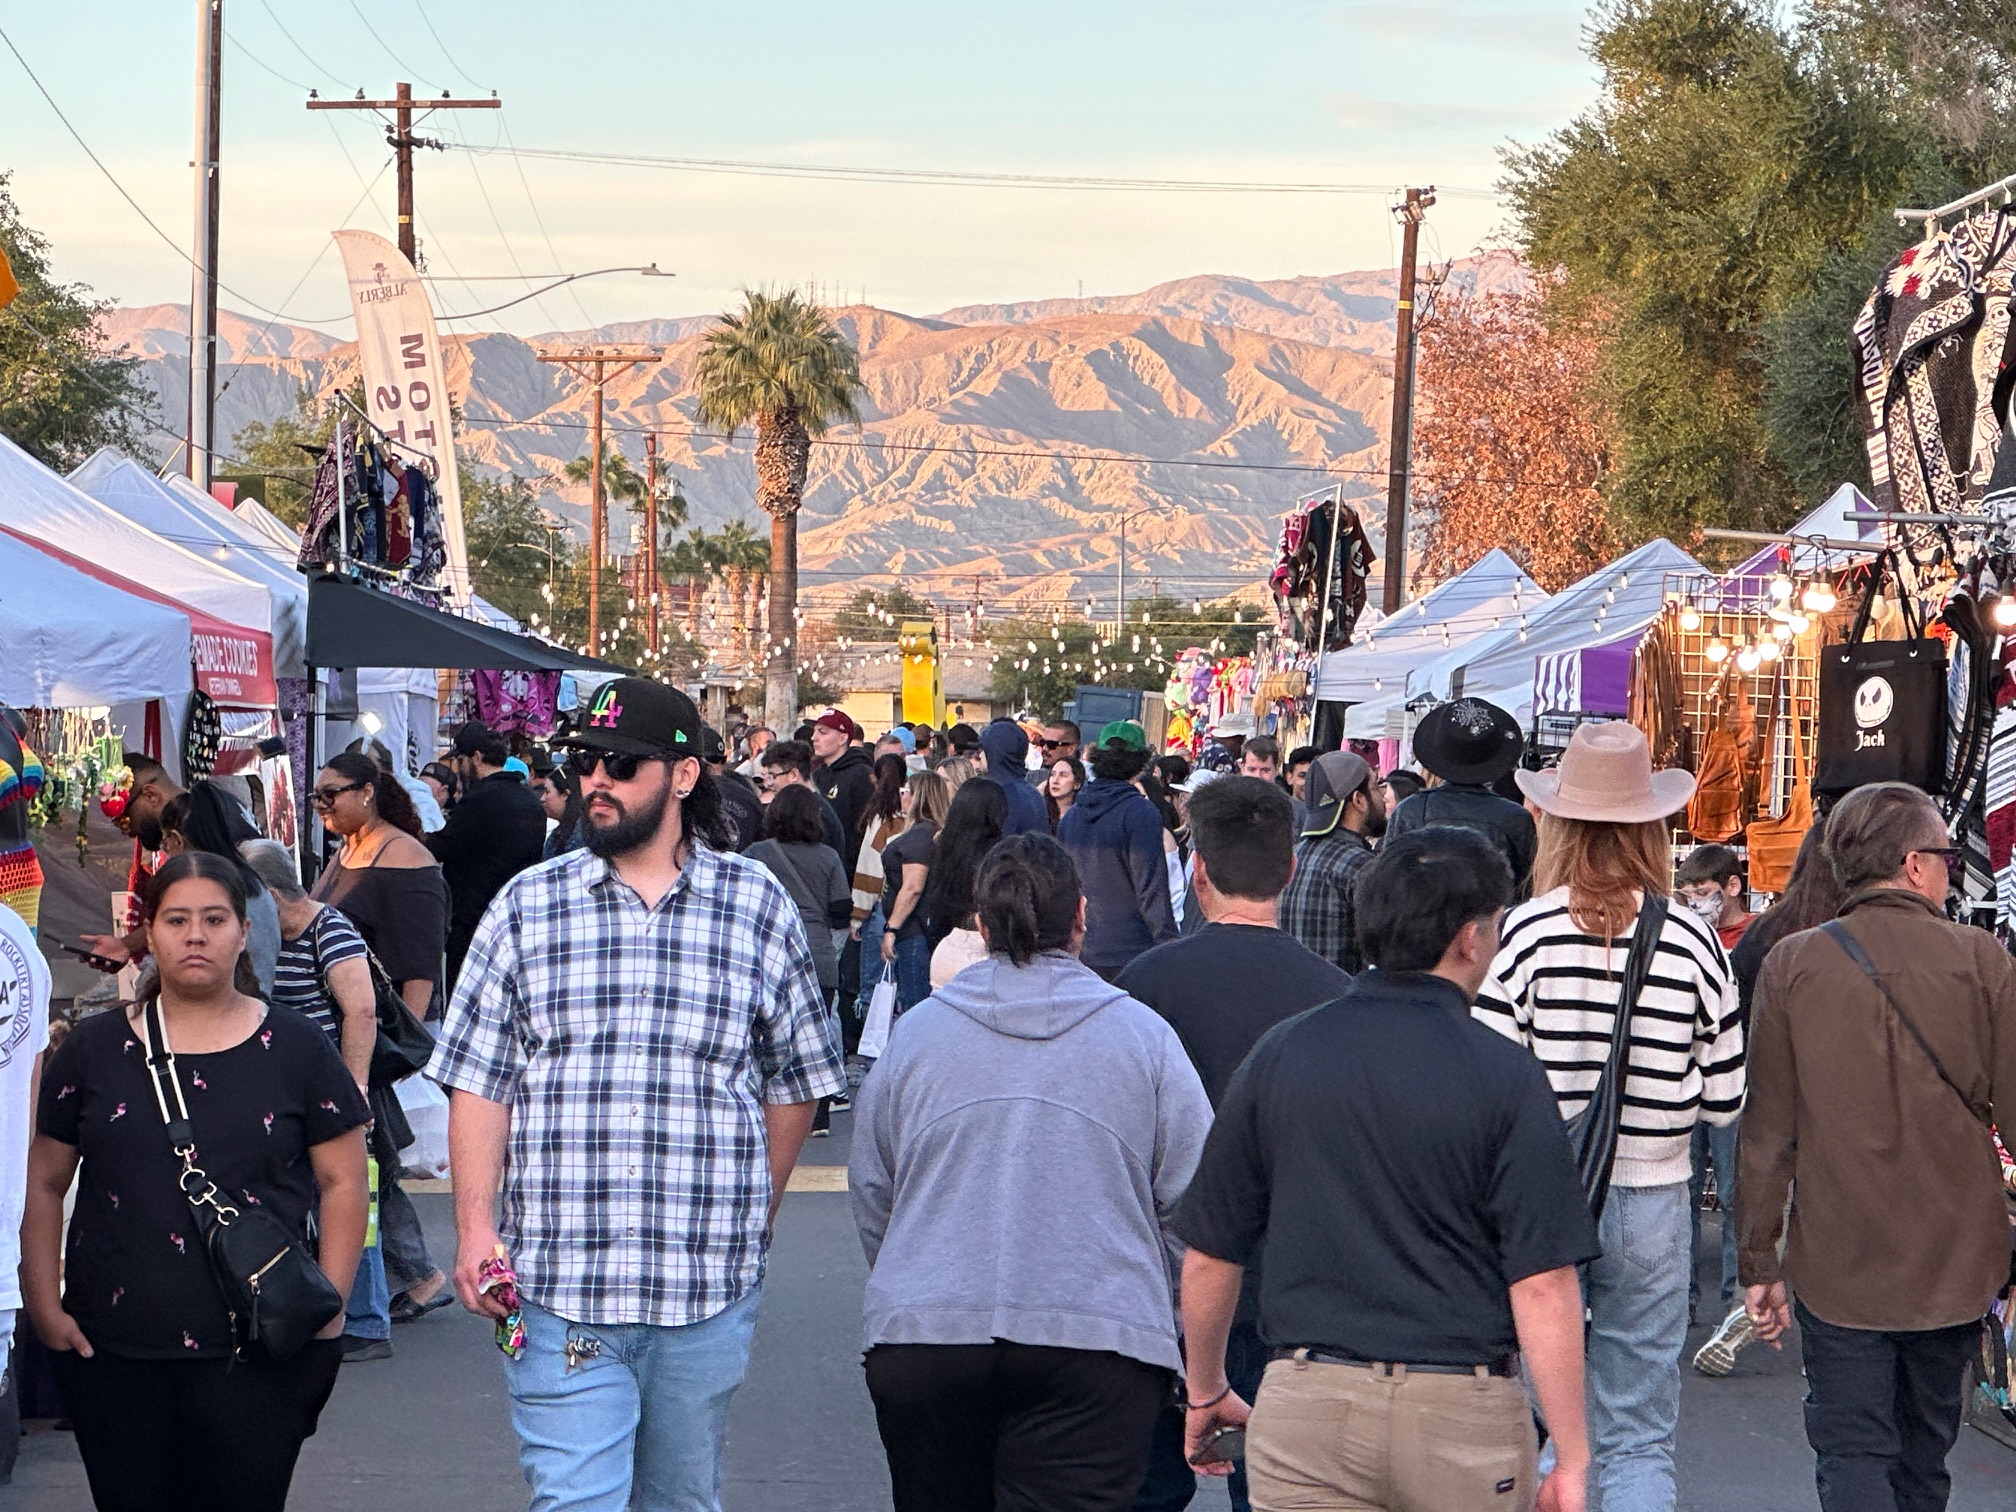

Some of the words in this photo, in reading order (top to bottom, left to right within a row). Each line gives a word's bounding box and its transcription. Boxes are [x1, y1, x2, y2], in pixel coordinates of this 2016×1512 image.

[193, 634, 226, 672] EMADE
[222, 637, 258, 677] COOKIES
[590, 682, 623, 728] LA
[1854, 729, 1885, 752] Jack
